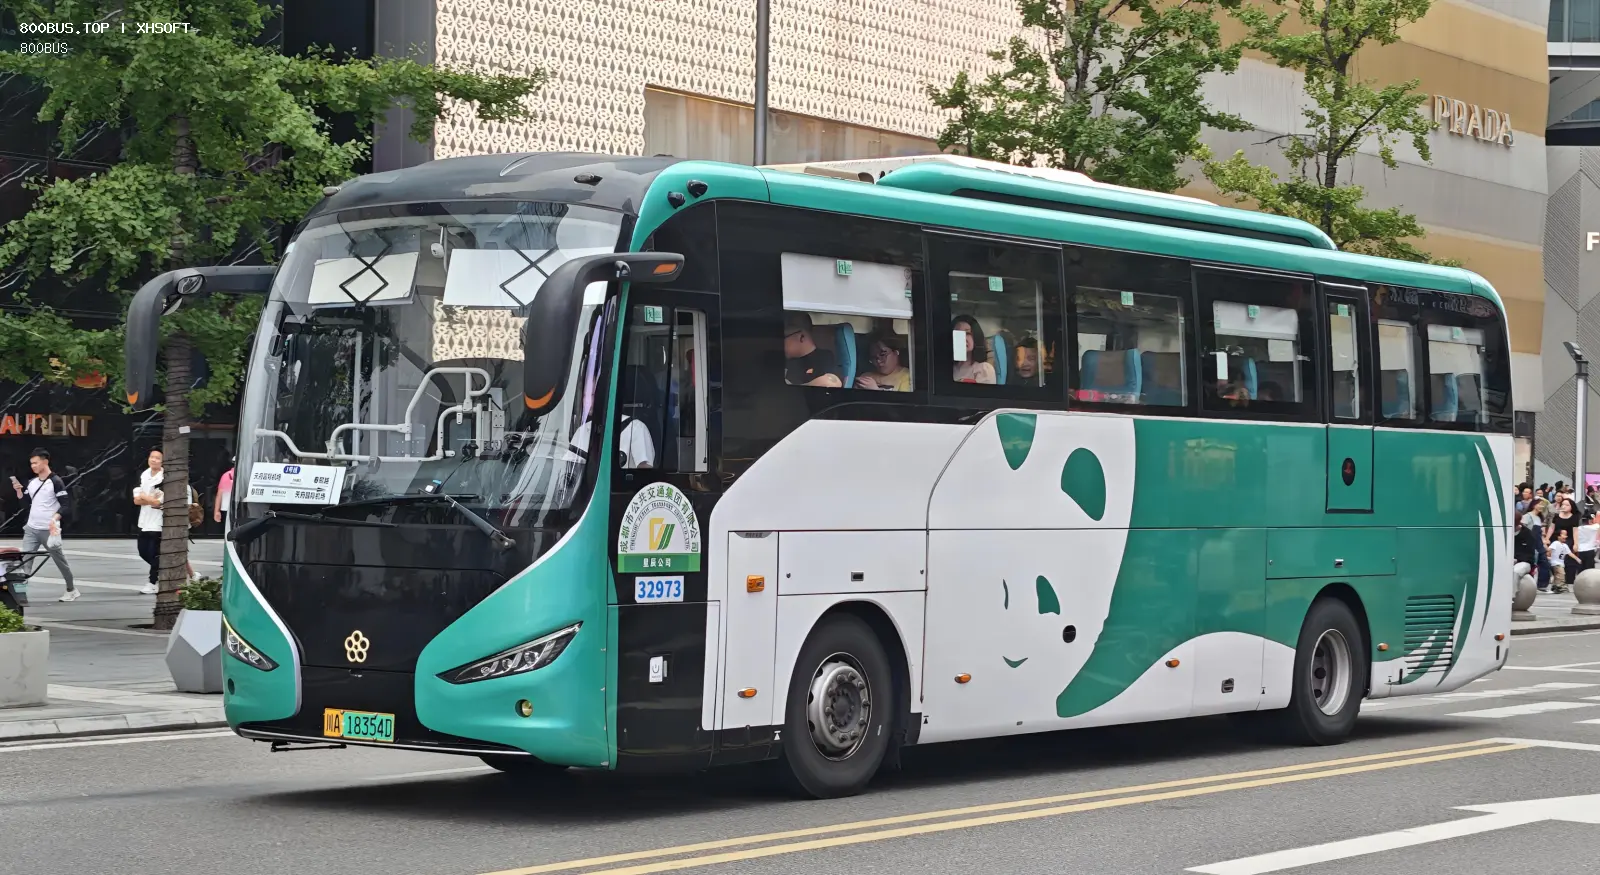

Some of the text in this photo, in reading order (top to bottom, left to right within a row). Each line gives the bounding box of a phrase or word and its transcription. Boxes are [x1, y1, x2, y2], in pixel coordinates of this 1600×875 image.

[1433, 94, 1515, 146] PRADA
[620, 485, 699, 553] 成都市公共交通集团有限公司
[638, 580, 682, 598] 32973
